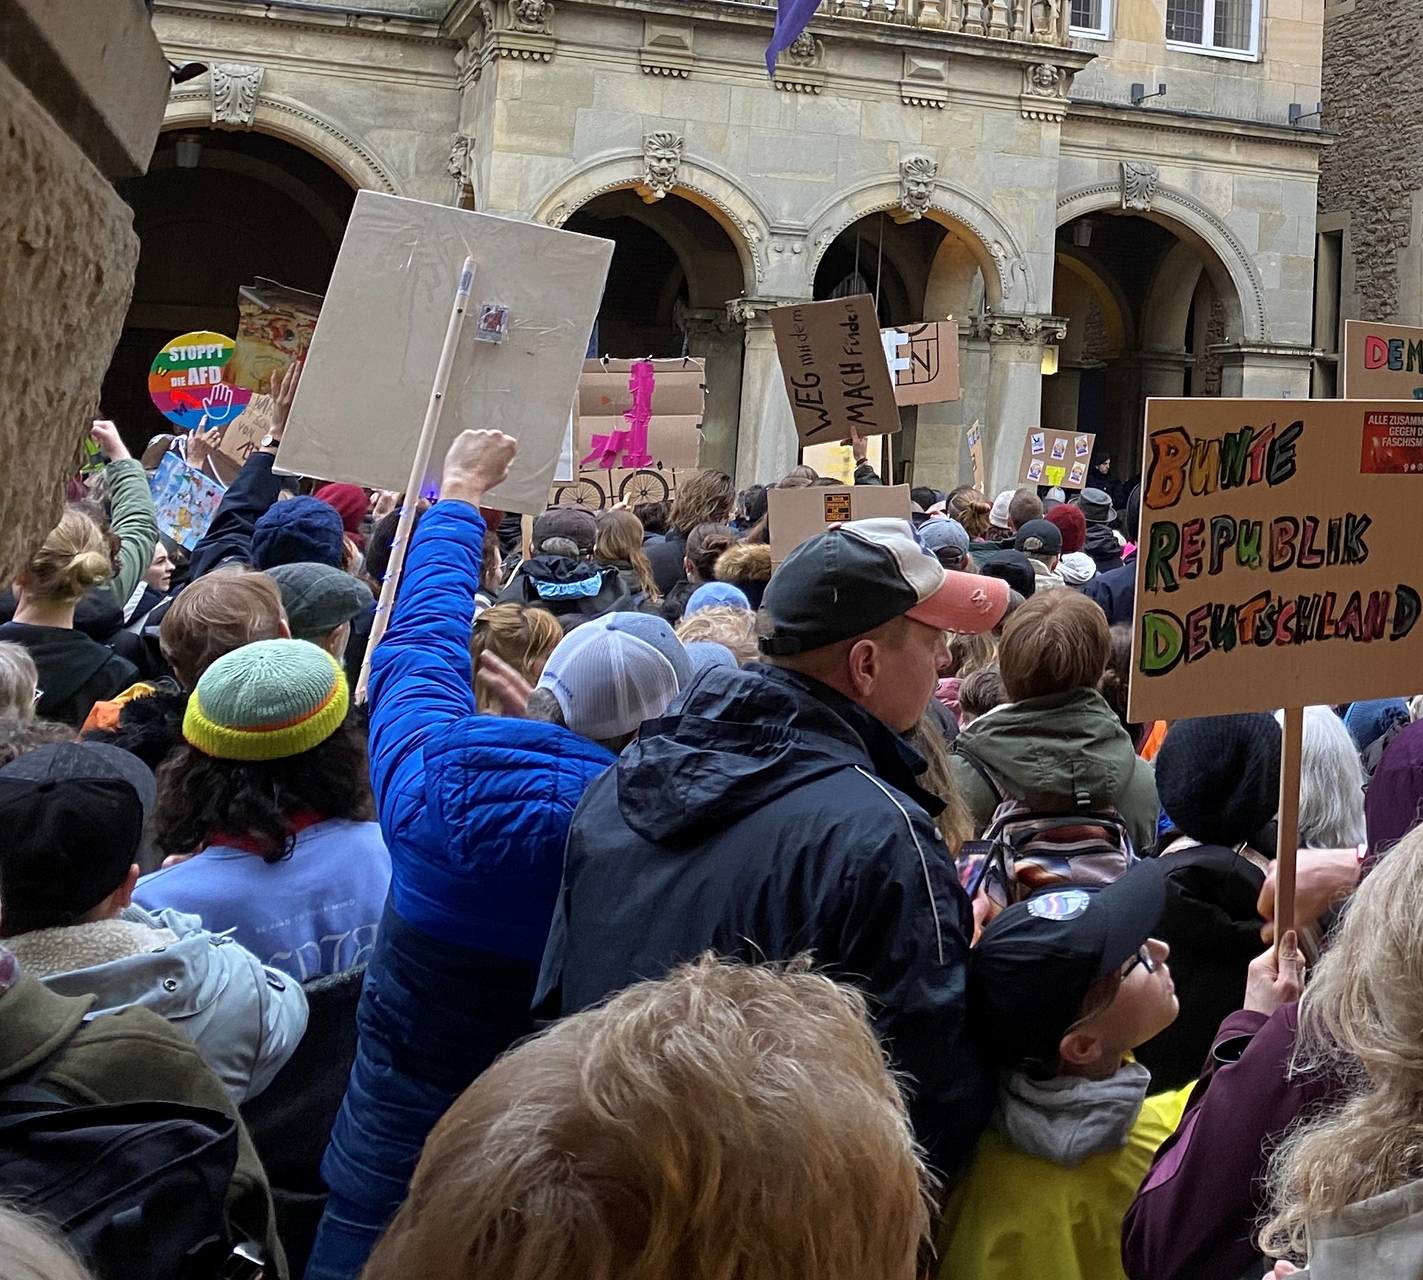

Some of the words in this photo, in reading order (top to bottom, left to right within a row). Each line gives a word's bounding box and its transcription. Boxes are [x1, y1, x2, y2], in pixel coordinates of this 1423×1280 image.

[169, 343, 224, 362] STOPPT
[170, 376, 186, 388] DIE
[187, 365, 220, 386] AFD
[790, 372, 831, 436] WEG
[838, 362, 877, 426] MACH
[1368, 414, 1388, 425] ALLE
[1389, 426, 1417, 437] GEGEN
[1144, 420, 1304, 510] BUNTE
[1145, 512, 1373, 594] REPUBLIK
[1140, 584, 1422, 677] DEUTSCHLAND
